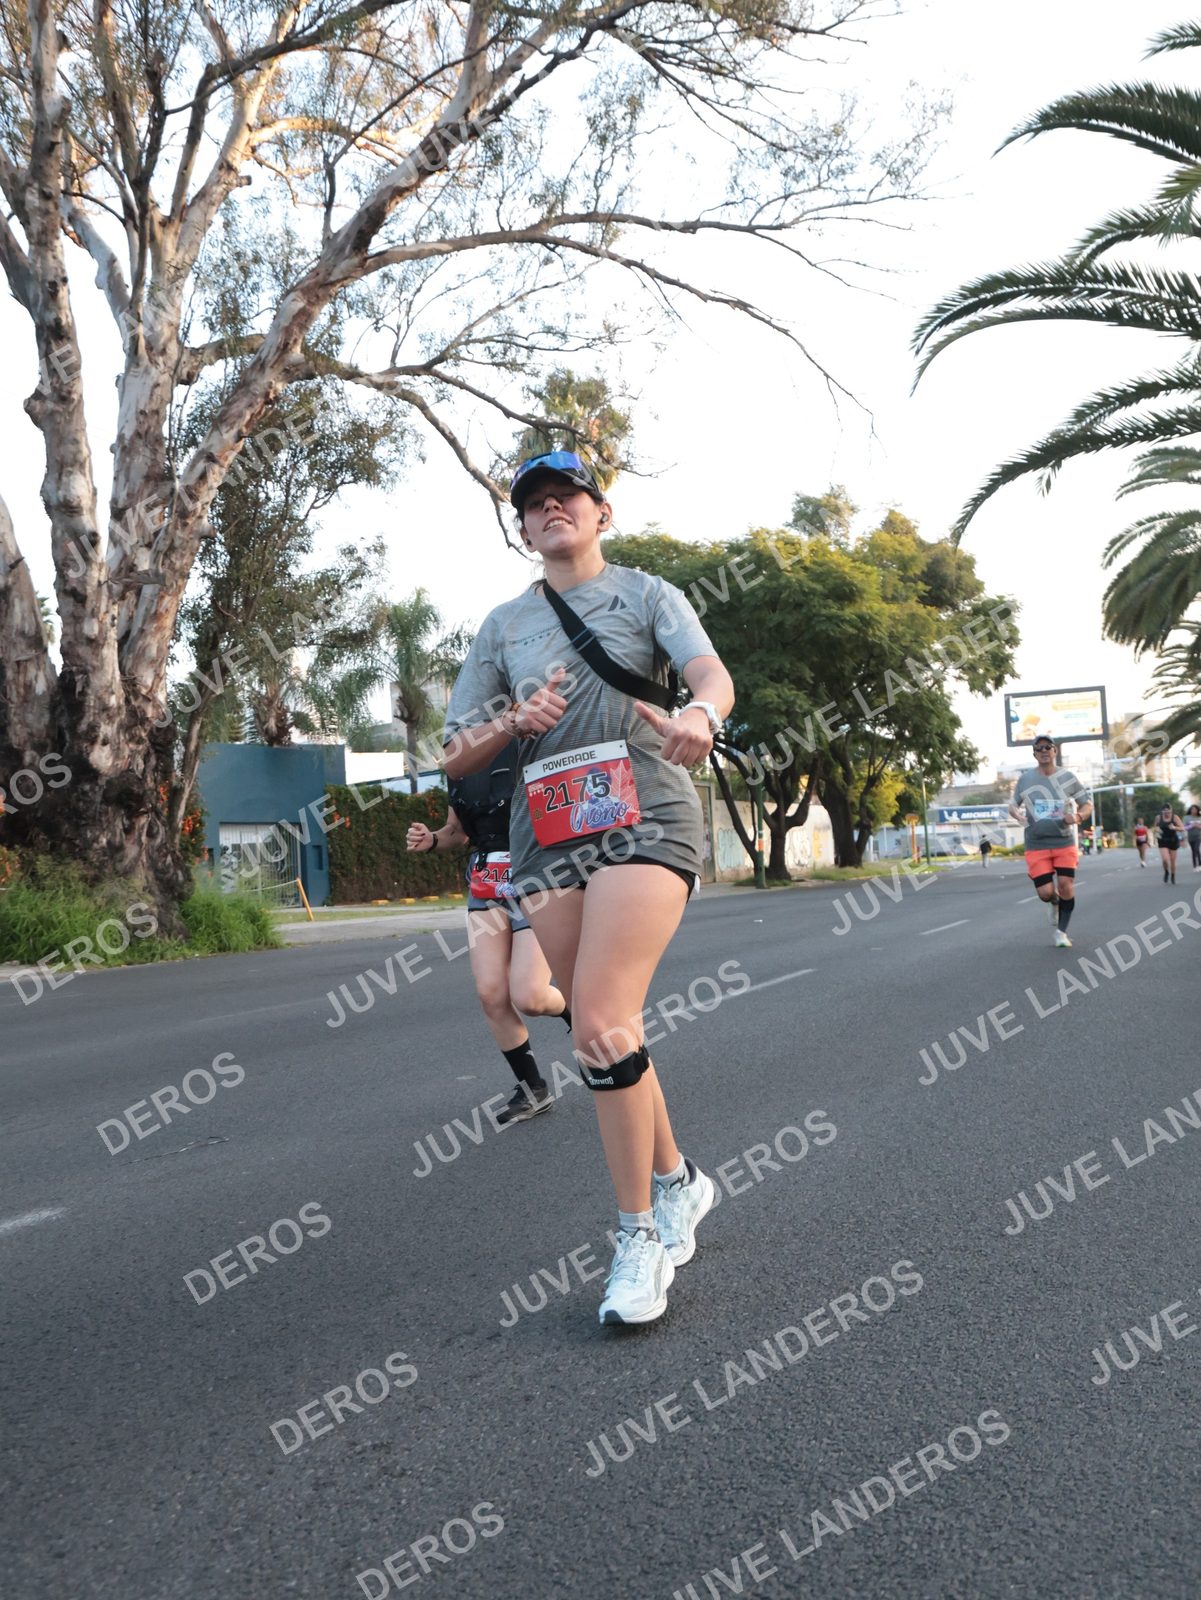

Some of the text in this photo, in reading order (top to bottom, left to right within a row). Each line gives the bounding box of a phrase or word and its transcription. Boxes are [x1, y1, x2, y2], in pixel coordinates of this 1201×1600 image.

[543, 751, 596, 772] POWERADE
[543, 772, 611, 812] 2175
[482, 867, 513, 884] 214
